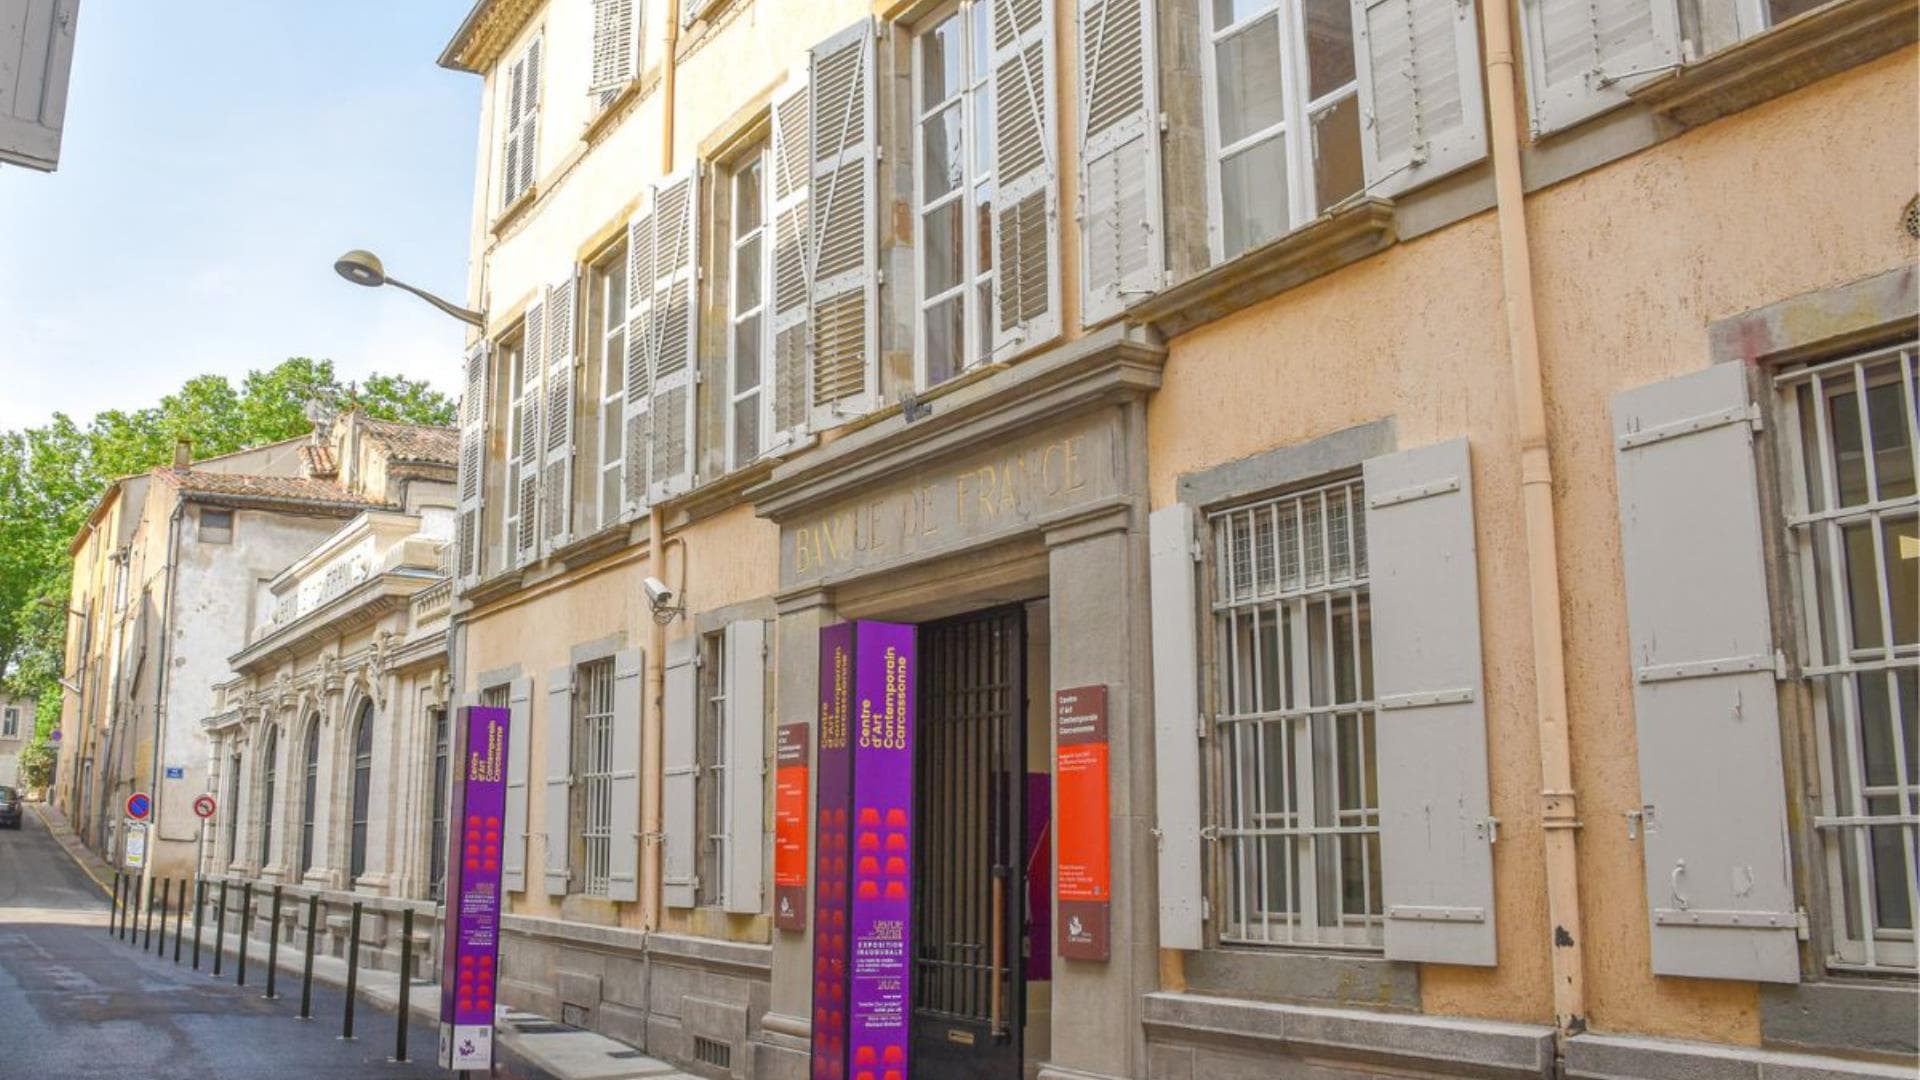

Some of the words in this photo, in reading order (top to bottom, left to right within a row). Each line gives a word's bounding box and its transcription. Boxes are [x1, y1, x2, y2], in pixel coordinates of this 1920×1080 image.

[903, 485, 938, 536] DE
[884, 646, 897, 749] Contemporain
[895, 656, 906, 750] Carcassonne
[859, 699, 871, 748] Centre
[872, 713, 882, 749] d'Art
[857, 941, 903, 949] EXPOSITION
